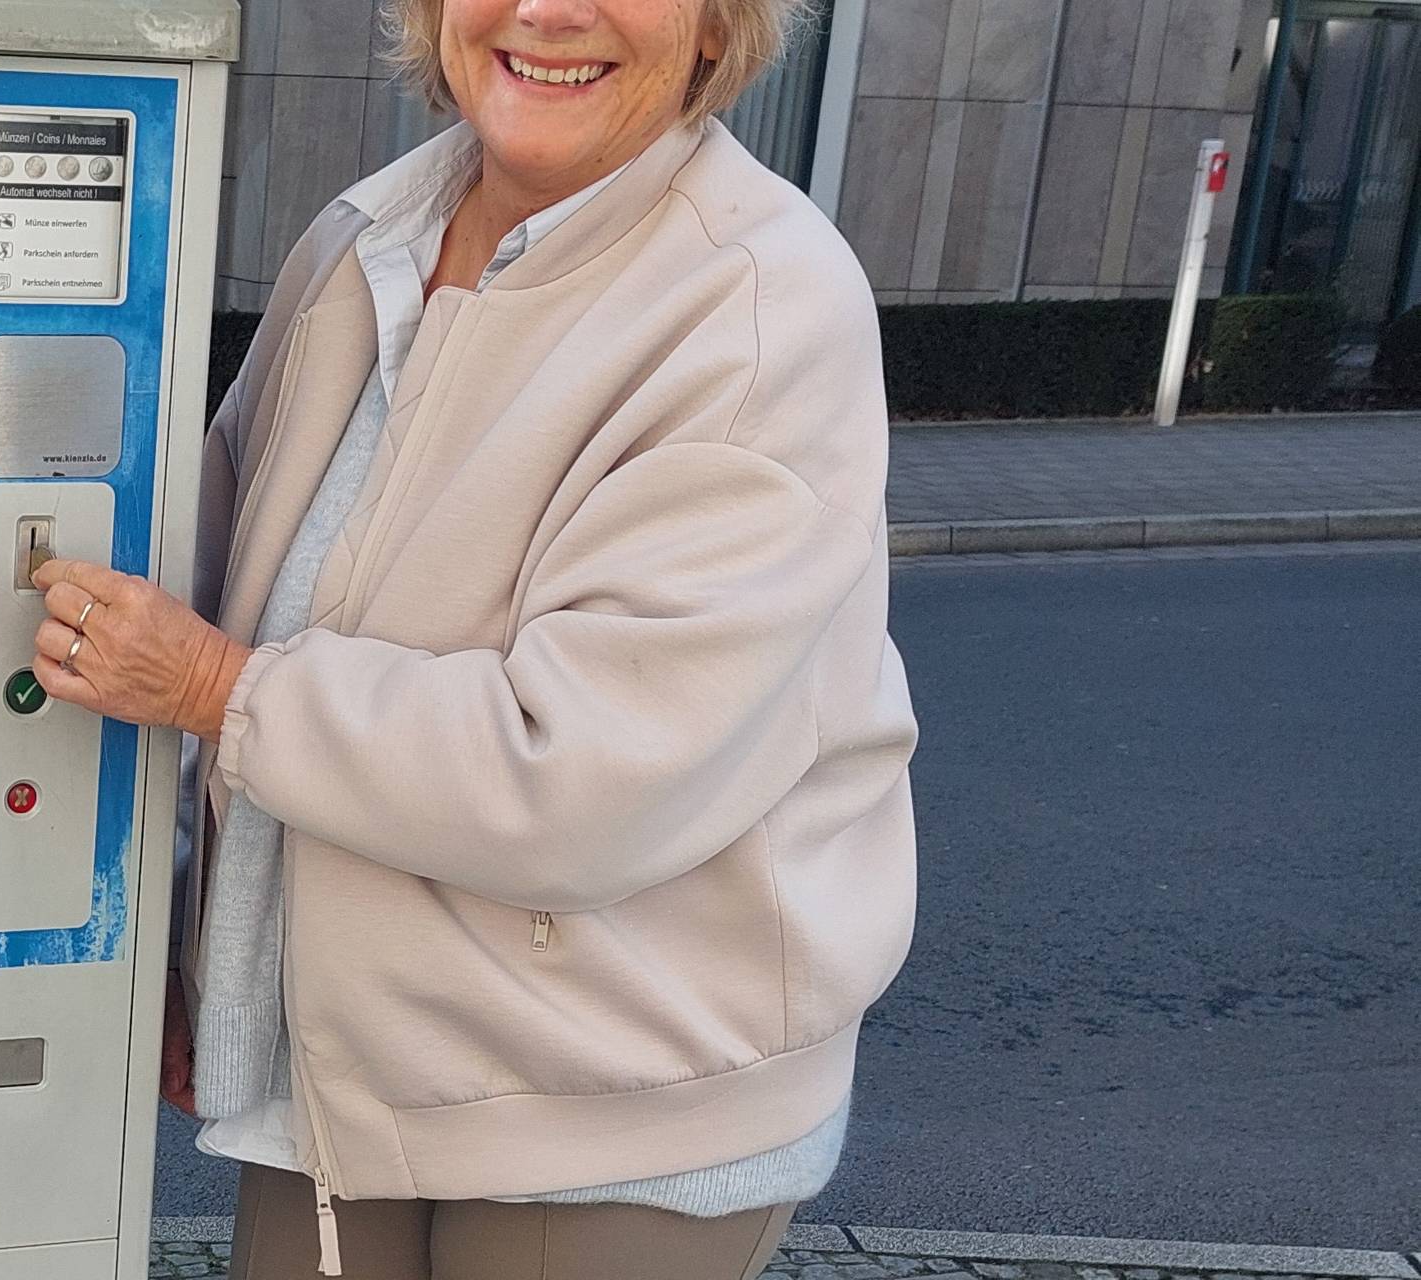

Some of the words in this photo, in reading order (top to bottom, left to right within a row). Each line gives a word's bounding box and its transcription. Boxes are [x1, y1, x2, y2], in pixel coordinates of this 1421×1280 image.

[31, 132, 36, 144] /
[37, 133, 60, 144] Coins
[61, 134, 66, 145] /
[67, 135, 107, 146] Monnaies
[0, 185, 34, 197] Automat
[36, 187, 72, 198] wechselt
[73, 188, 93, 199] nicht
[25, 219, 50, 227] Münze
[51, 220, 87, 228] einwerfen
[23, 249, 62, 258] Parkschein
[64, 250, 99, 258] anfordern
[22, 279, 61, 288] Parkschein
[62, 279, 103, 288] entnehmen
[43, 454, 107, 463] www.kienzle.de
